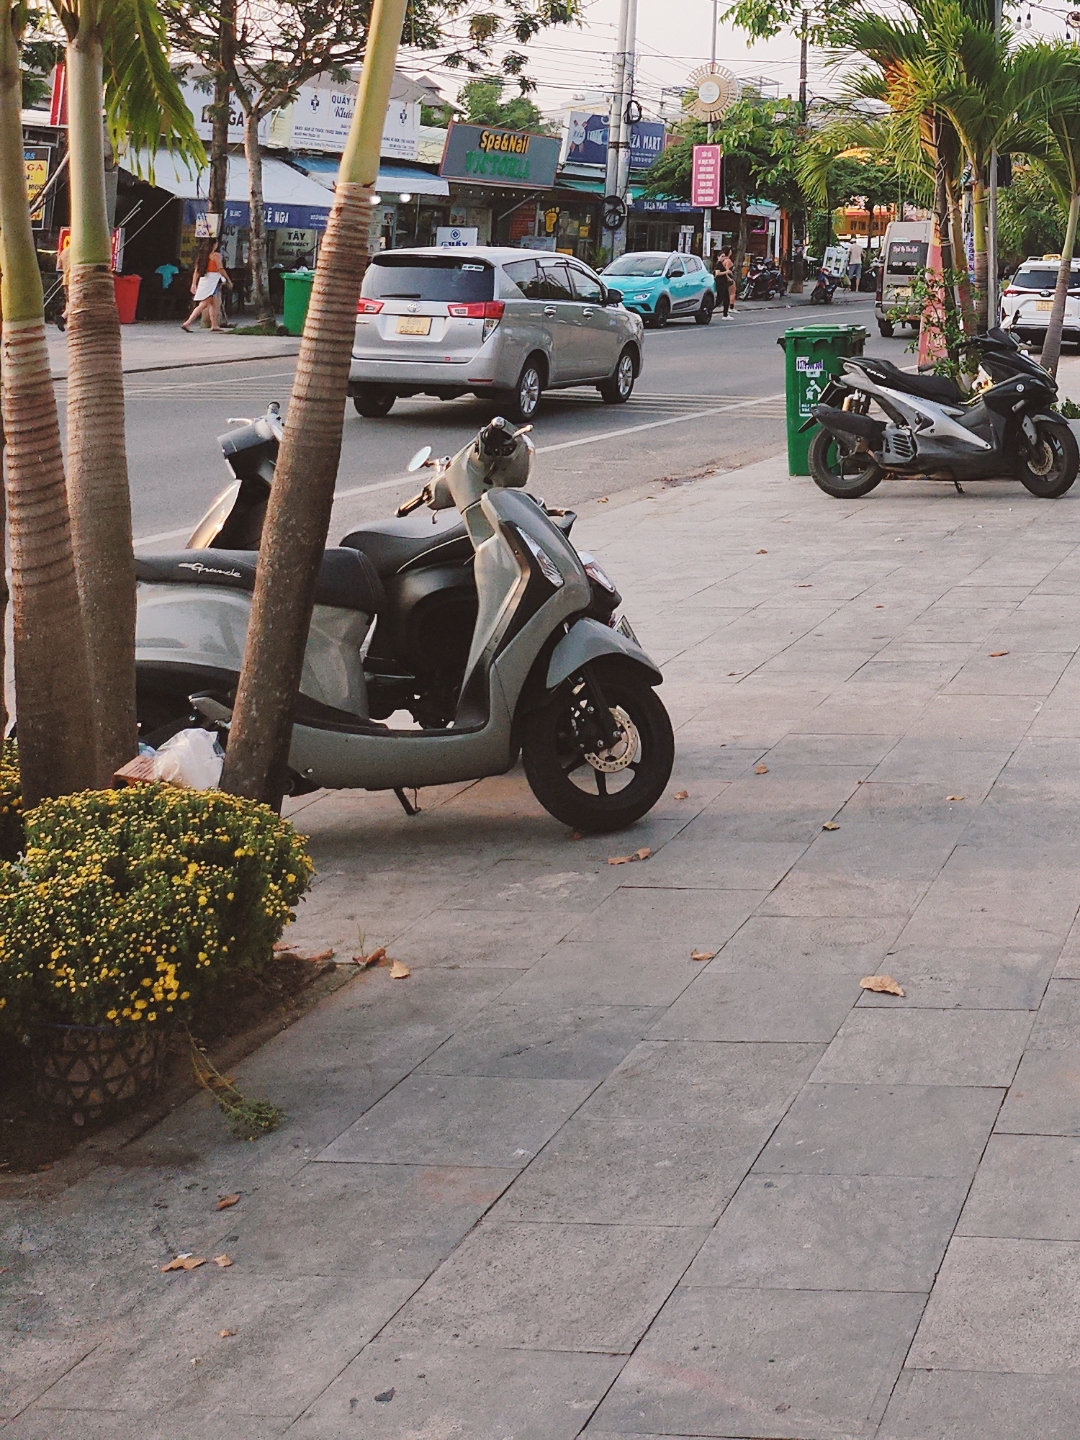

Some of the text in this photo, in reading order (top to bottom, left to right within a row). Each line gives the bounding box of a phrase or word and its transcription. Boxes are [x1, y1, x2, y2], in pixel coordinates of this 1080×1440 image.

[480, 130, 531, 154] Spa&Nail
[631, 134, 661, 150] ZA MART
[274, 211, 289, 224] NGA
[288, 230, 306, 241] TÂY
